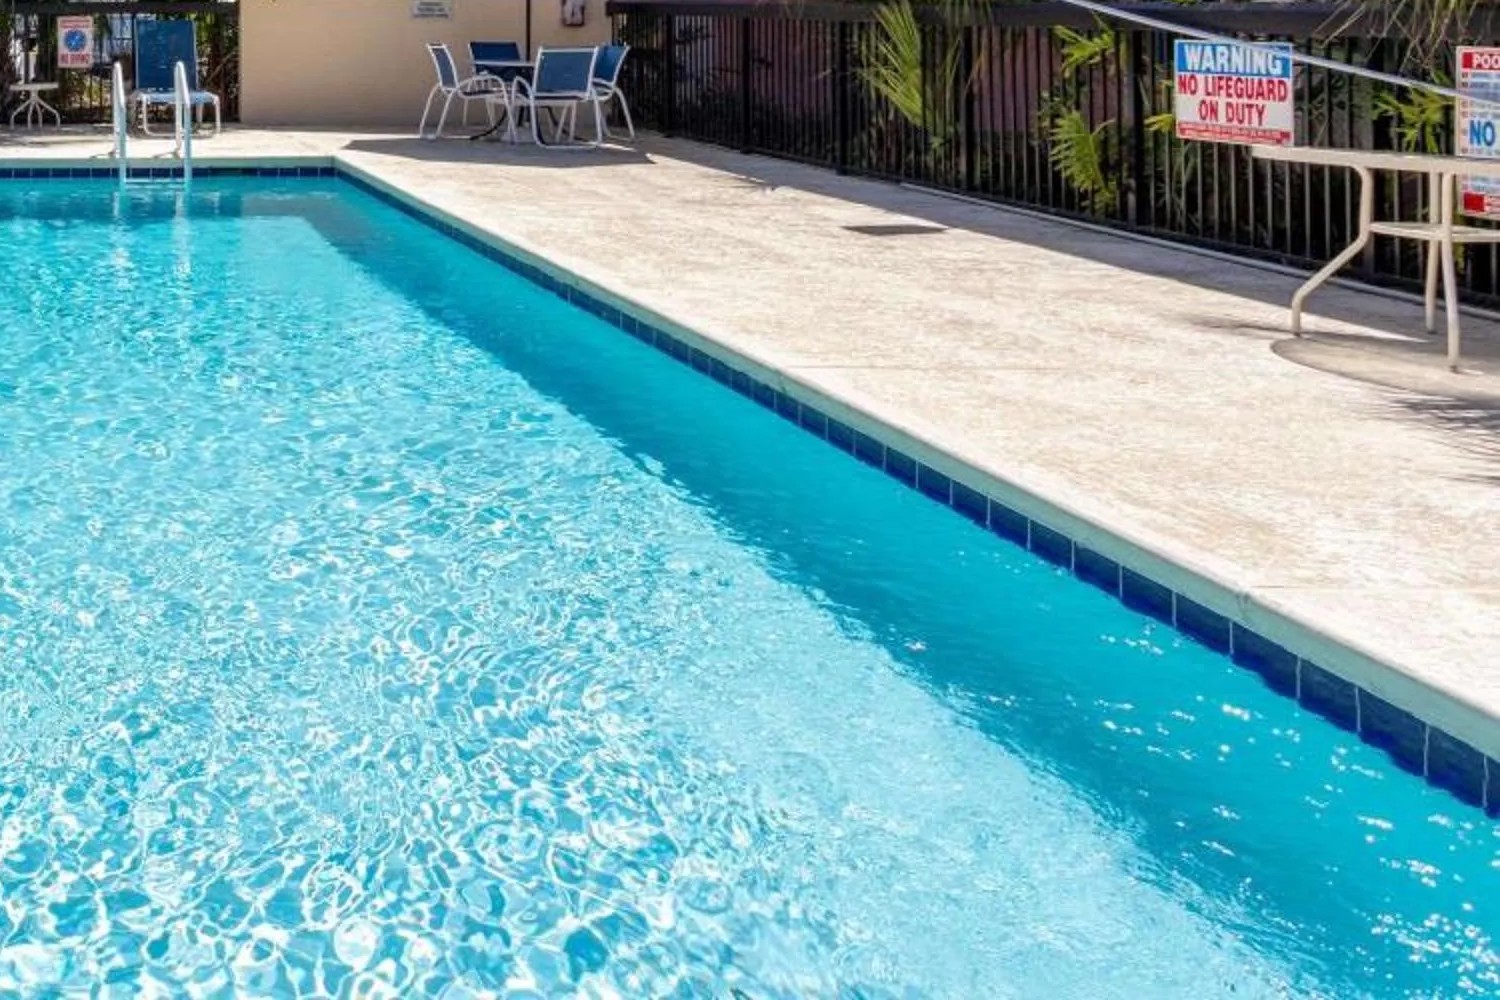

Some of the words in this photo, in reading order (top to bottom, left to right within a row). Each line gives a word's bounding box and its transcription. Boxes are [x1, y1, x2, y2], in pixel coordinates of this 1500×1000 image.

[1184, 45, 1282, 75] WARNING
[1178, 74, 1198, 95] NO
[1204, 76, 1288, 102] LIFEGUARD
[1199, 100, 1219, 121] ON
[1225, 102, 1266, 126] DUTY
[1469, 119, 1496, 146] NO
